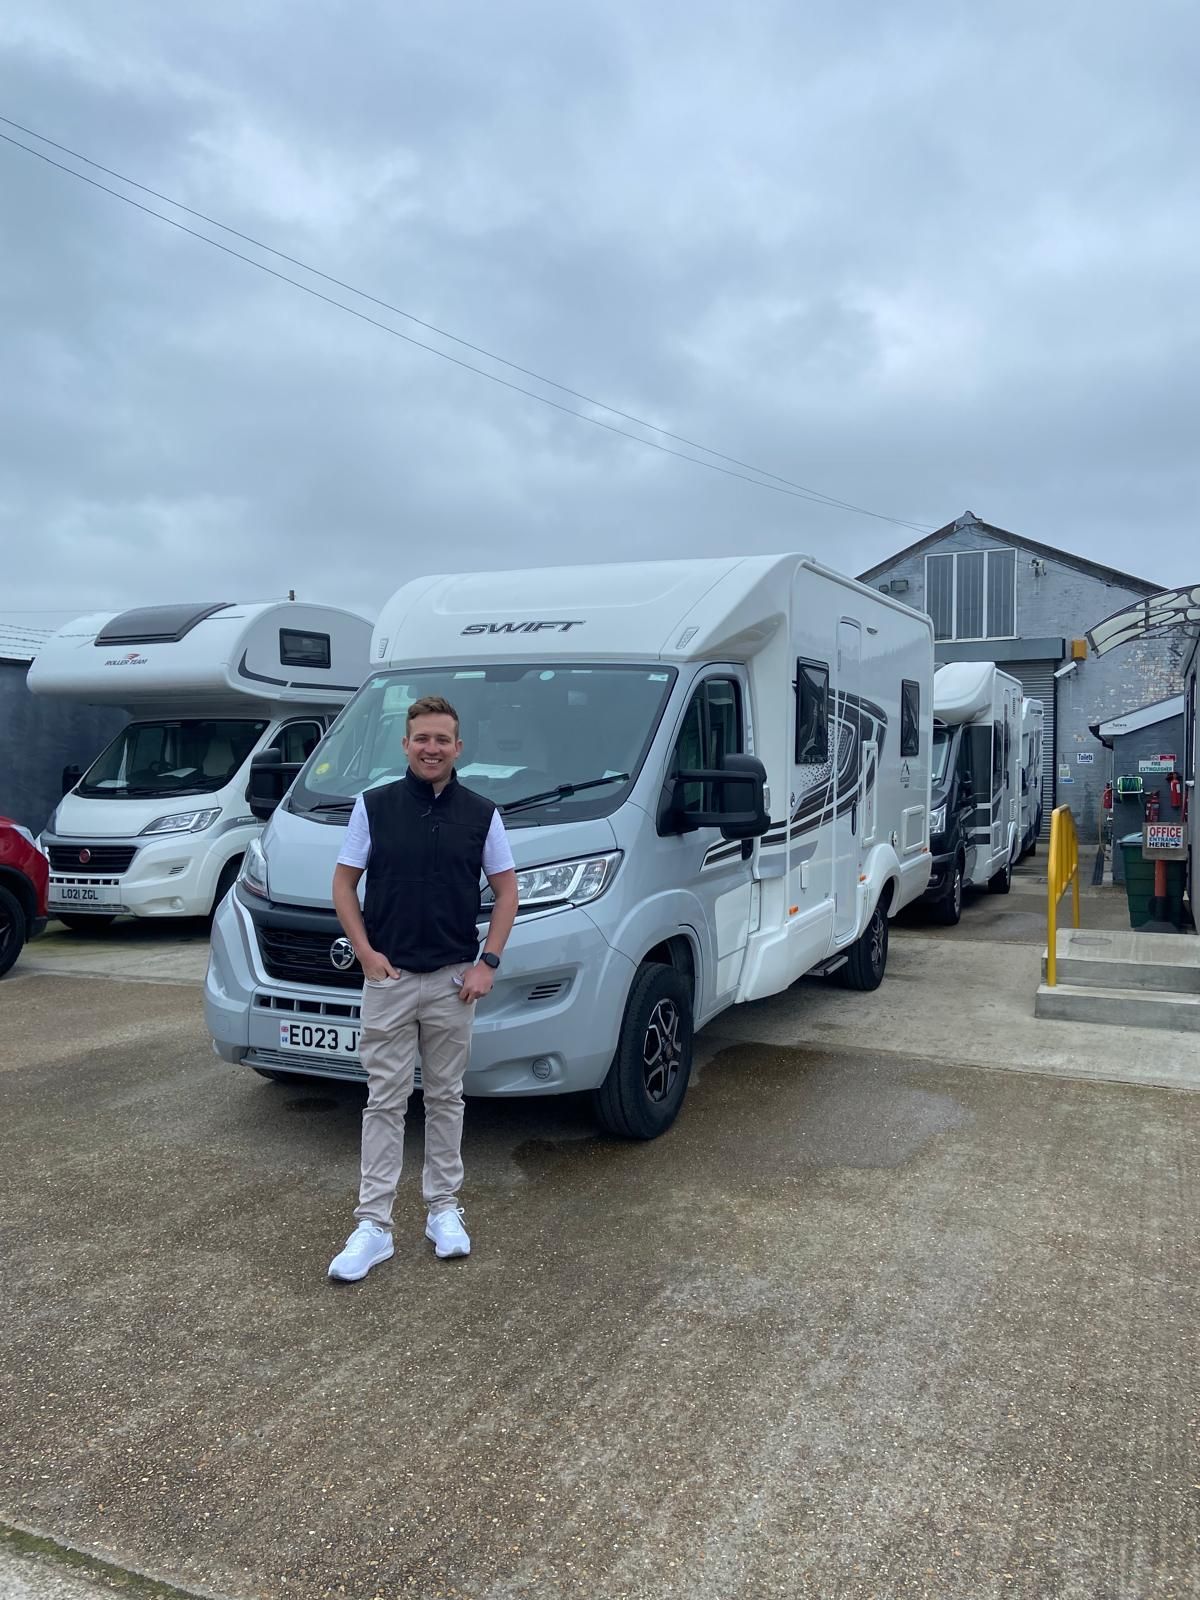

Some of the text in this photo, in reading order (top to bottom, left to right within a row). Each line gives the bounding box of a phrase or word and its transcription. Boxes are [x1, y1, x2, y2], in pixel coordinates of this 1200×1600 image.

[460, 620, 585, 635] SWIFT
[1078, 753, 1093, 761] Toilets
[1149, 826, 1182, 838] OFFICE
[82, 889, 99, 900] ZGL
